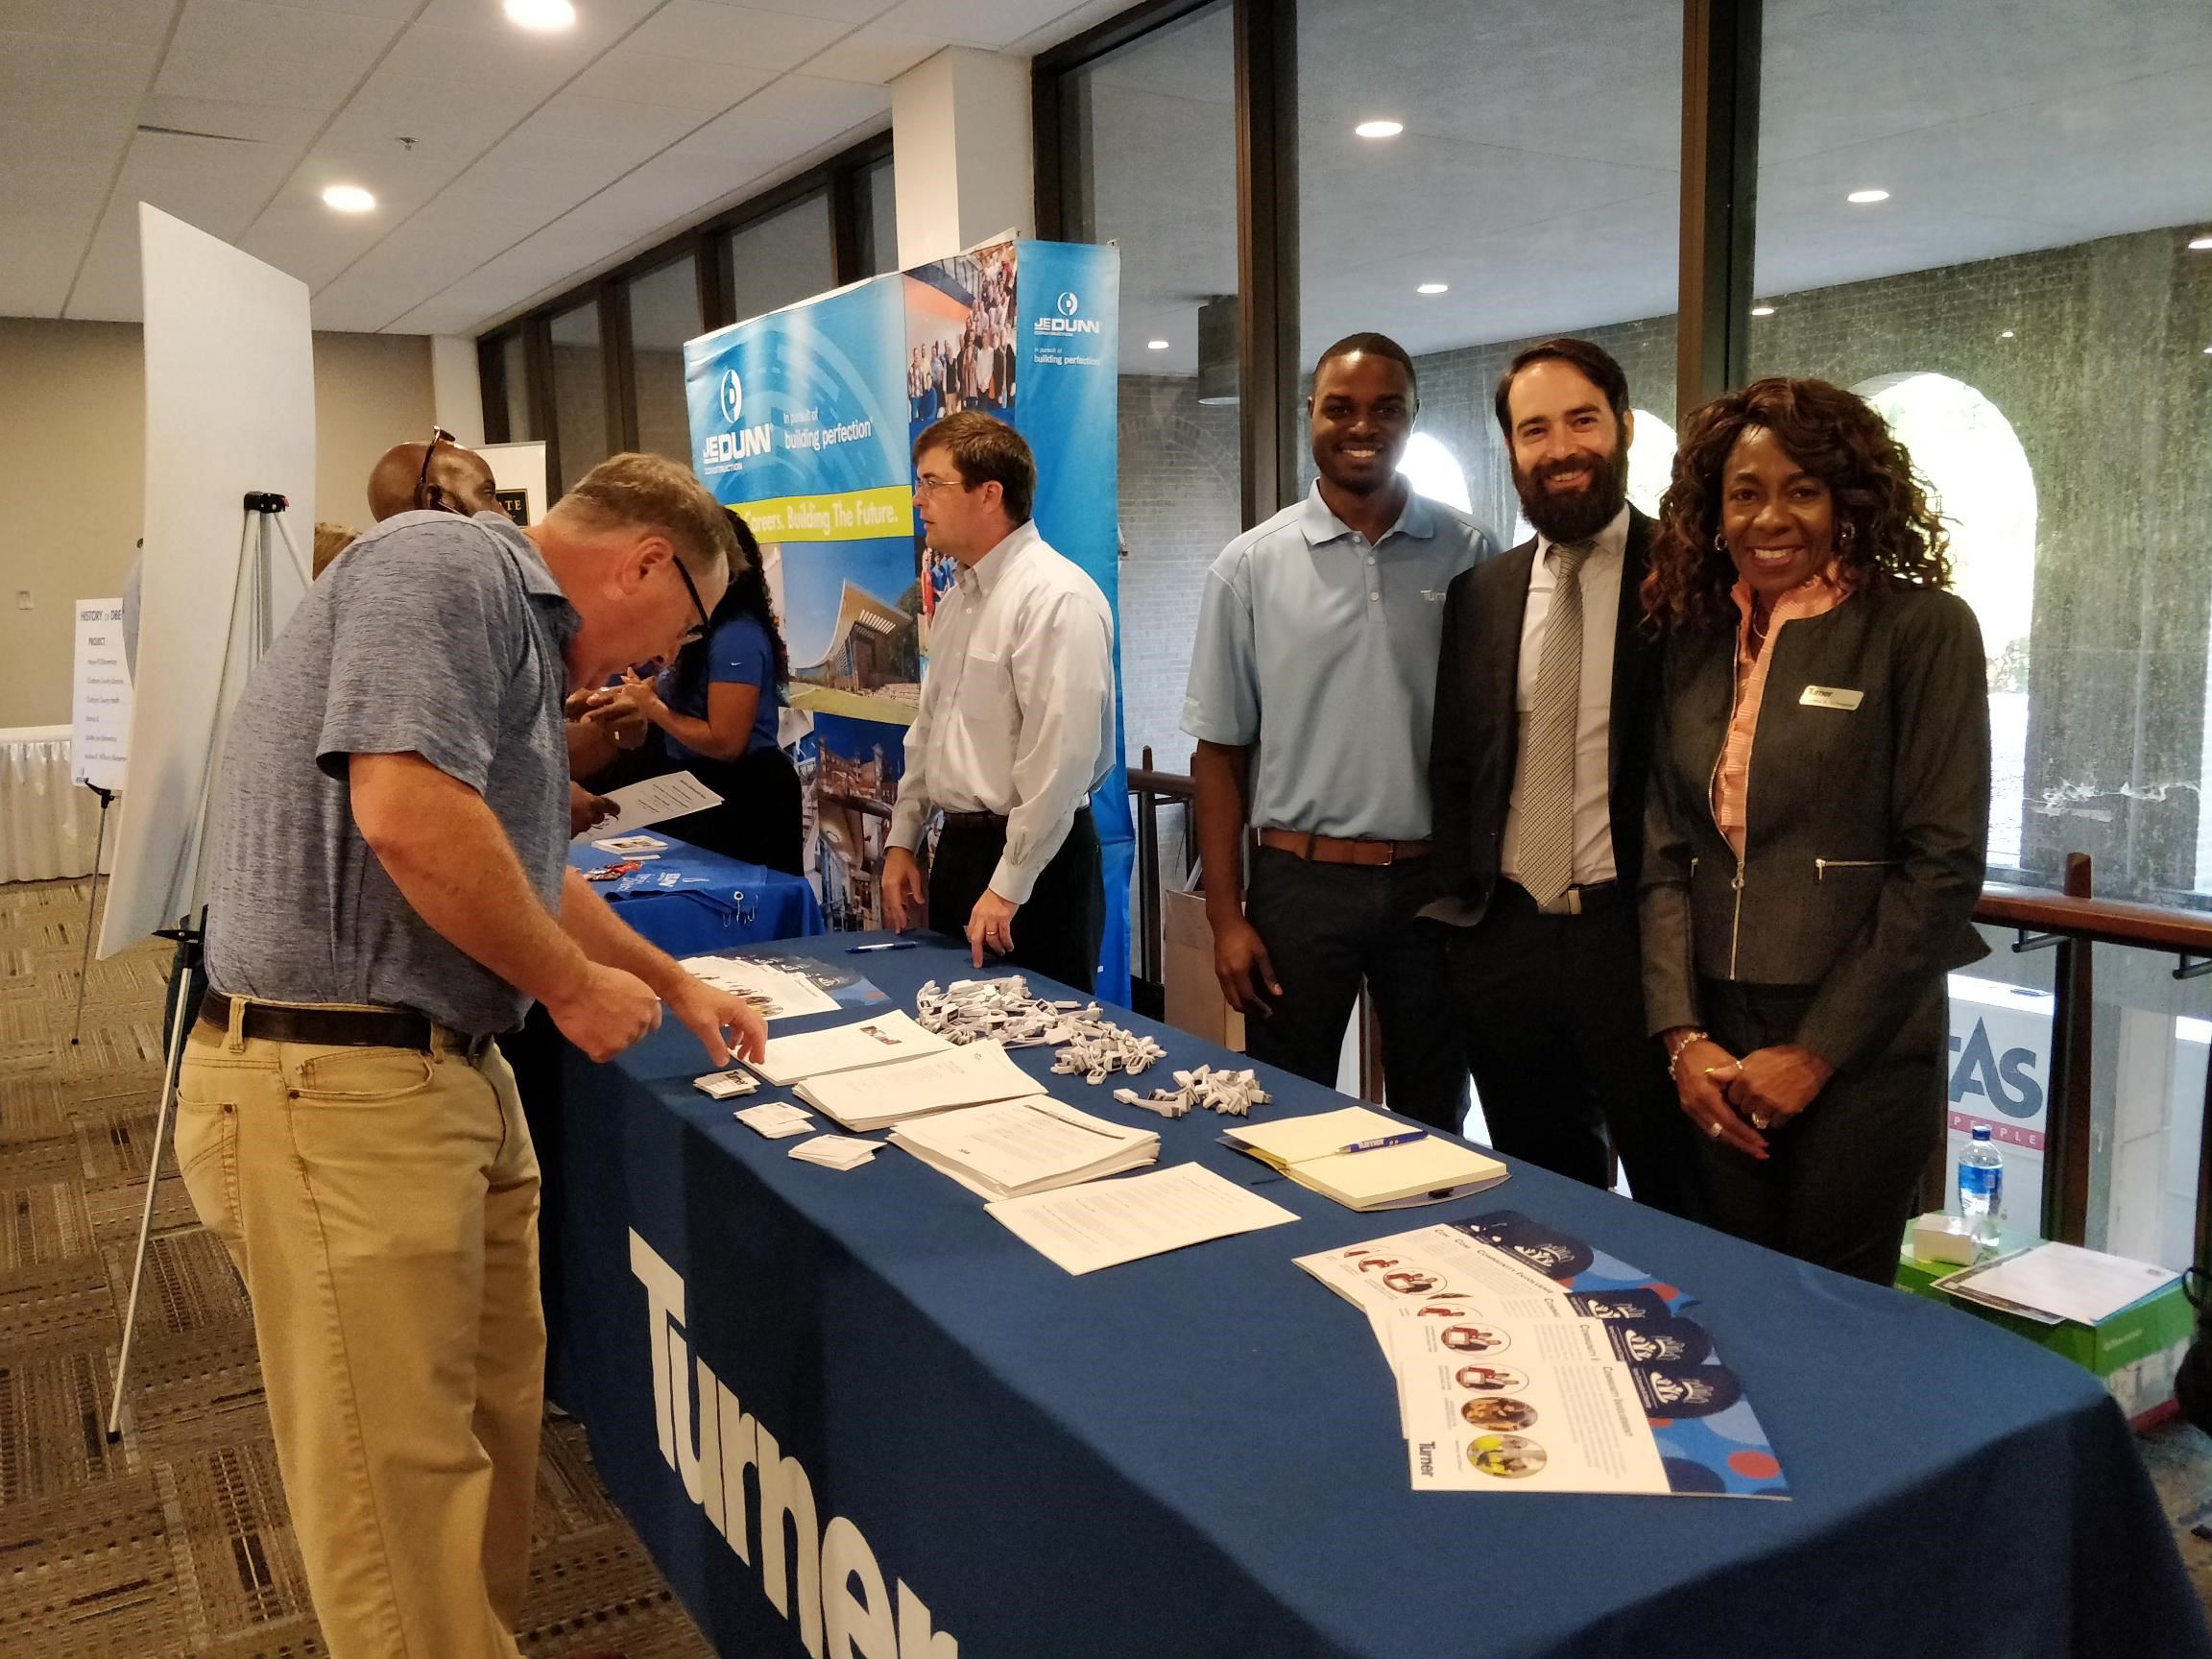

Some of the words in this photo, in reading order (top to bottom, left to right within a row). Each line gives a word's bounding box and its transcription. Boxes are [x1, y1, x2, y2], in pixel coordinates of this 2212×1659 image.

[1034, 355, 1062, 366] building
[1064, 356, 1101, 366] perfection
[783, 413, 790, 424] In
[811, 406, 819, 421] of
[784, 429, 821, 451] building
[823, 420, 872, 449] perfection
[787, 502, 830, 536] Building
[831, 501, 854, 527] The
[855, 500, 899, 526] Future.
[81, 611, 103, 621] HISTORY
[1419, 1441, 1435, 1478] Turner
